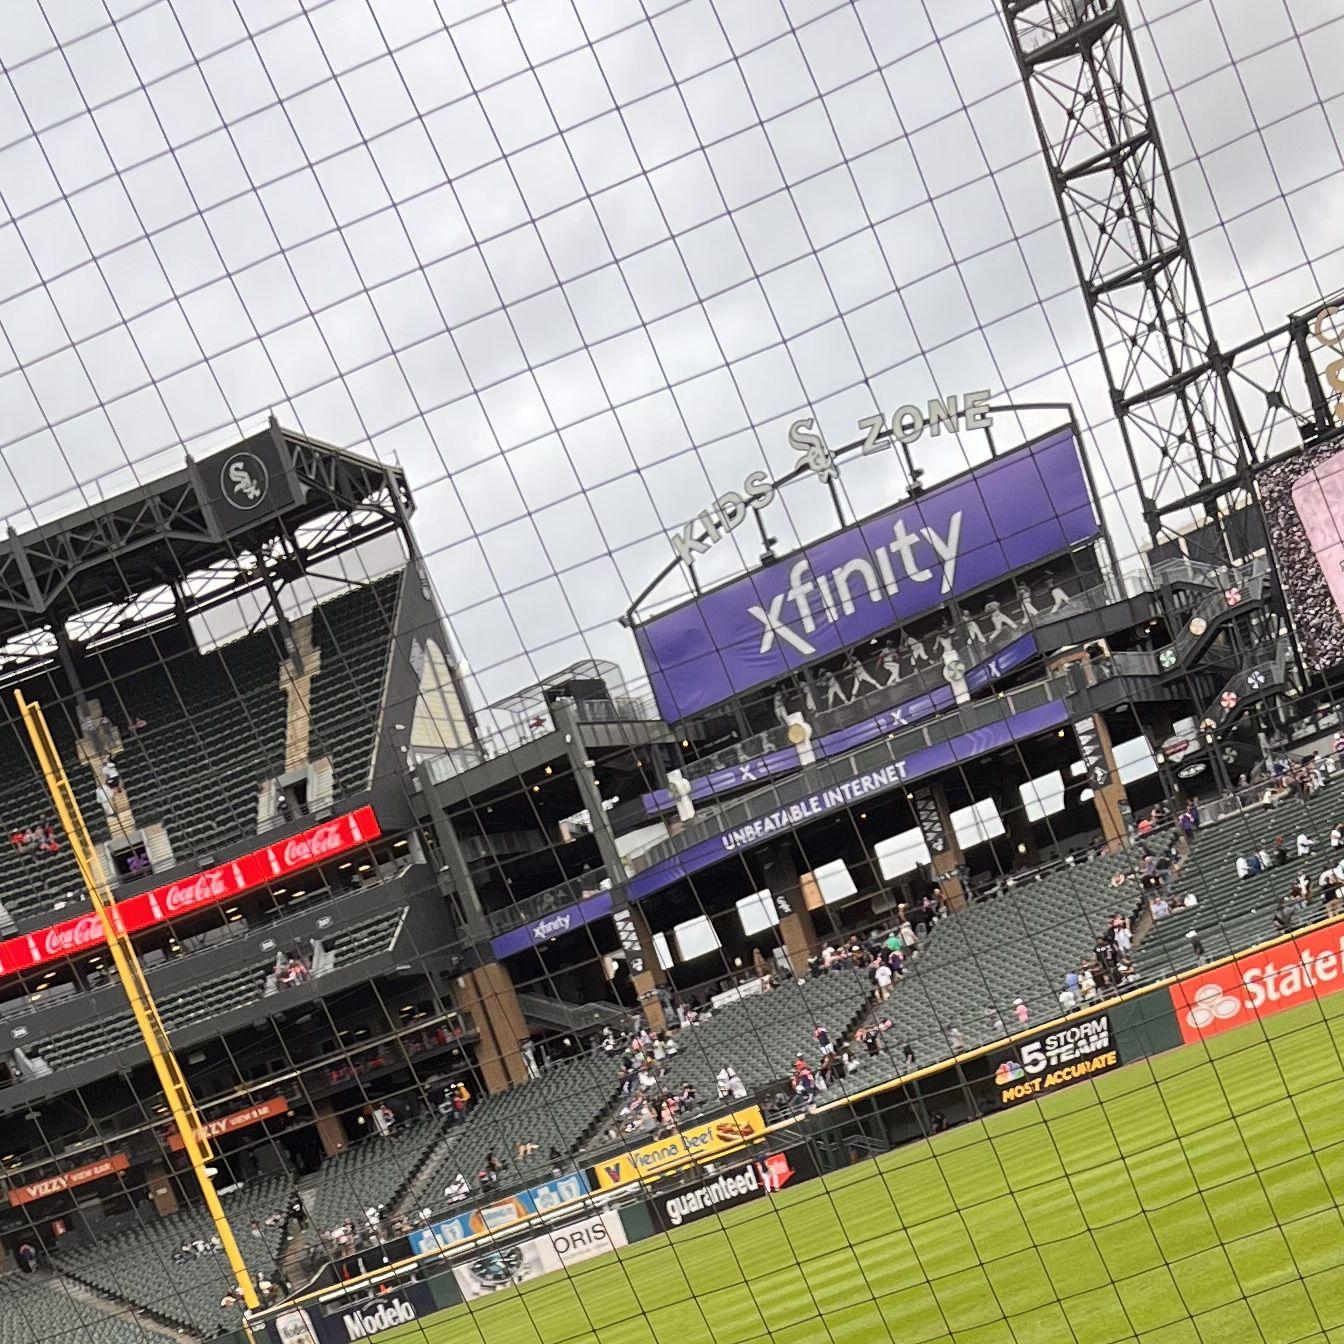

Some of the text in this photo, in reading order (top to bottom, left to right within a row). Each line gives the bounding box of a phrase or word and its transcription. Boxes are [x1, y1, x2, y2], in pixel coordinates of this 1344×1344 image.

[858, 389, 994, 456] ZONE
[671, 470, 776, 566] KIDS
[747, 510, 963, 656] xfinity
[721, 761, 907, 850] UNBEATABLE INTERNET
[1021, 1016, 1108, 1074] 5 STORM
[1045, 1030, 1109, 1066] TEAM
[1002, 1050, 1117, 1103] MOST ACCURATE
[666, 1163, 759, 1226] guaranteed
[553, 1222, 607, 1255] ORIS
[343, 1298, 416, 1342] Modelo
